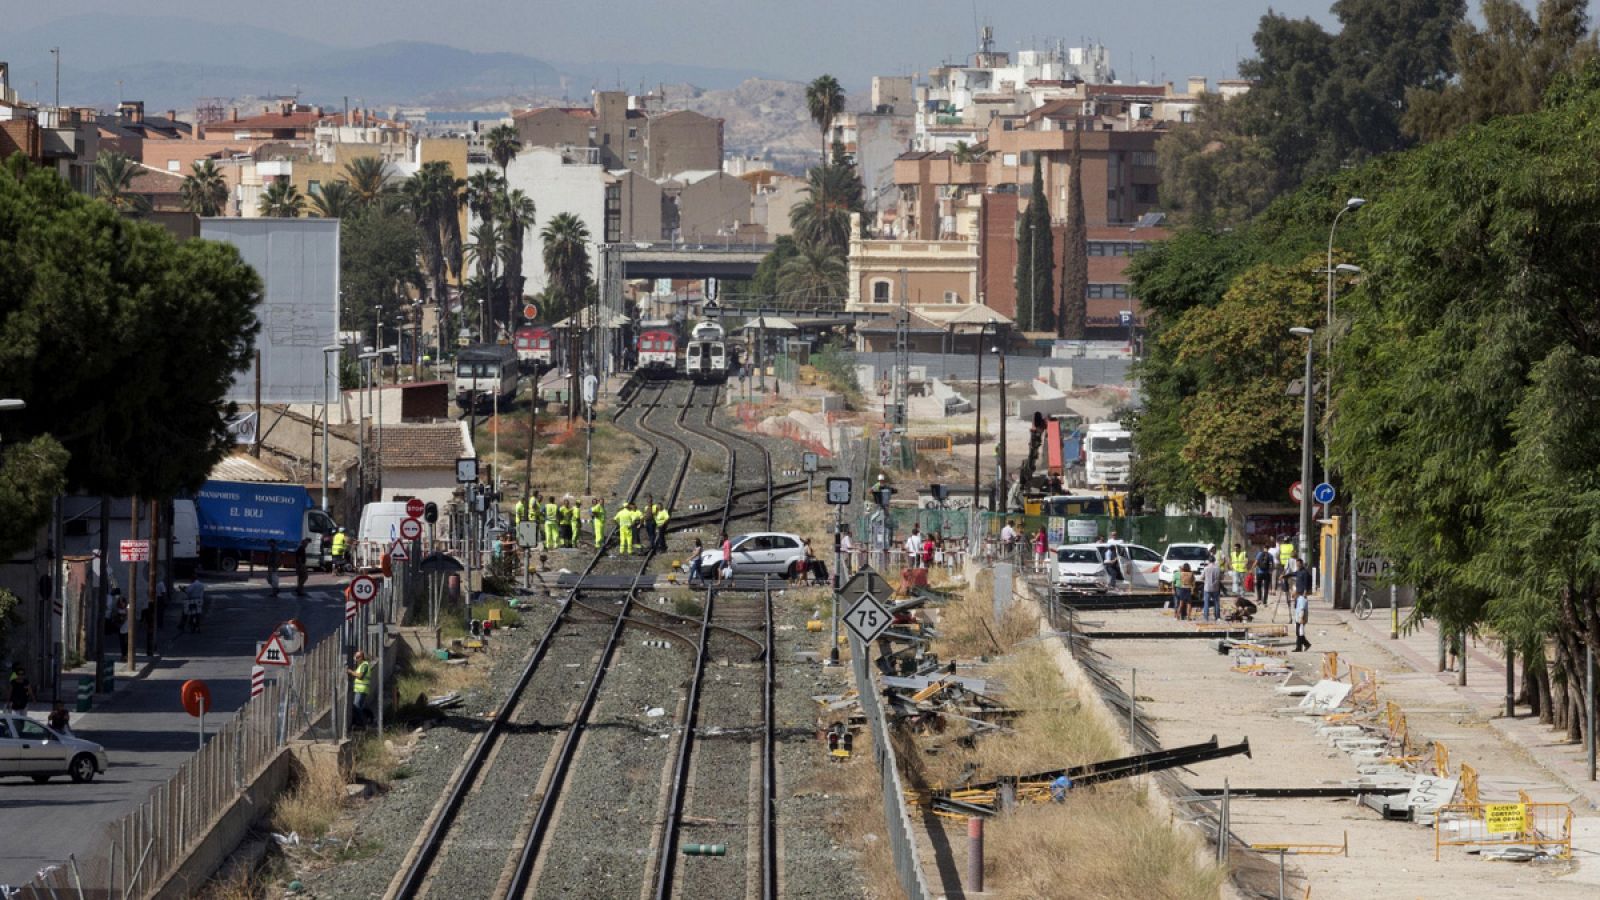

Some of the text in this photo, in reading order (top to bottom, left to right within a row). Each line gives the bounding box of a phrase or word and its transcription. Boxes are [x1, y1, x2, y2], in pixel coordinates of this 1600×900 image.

[255, 494, 296, 505] ROMERO
[230, 507, 264, 518] EL BOLI
[356, 584, 372, 594] 30
[857, 610, 877, 628] 75
